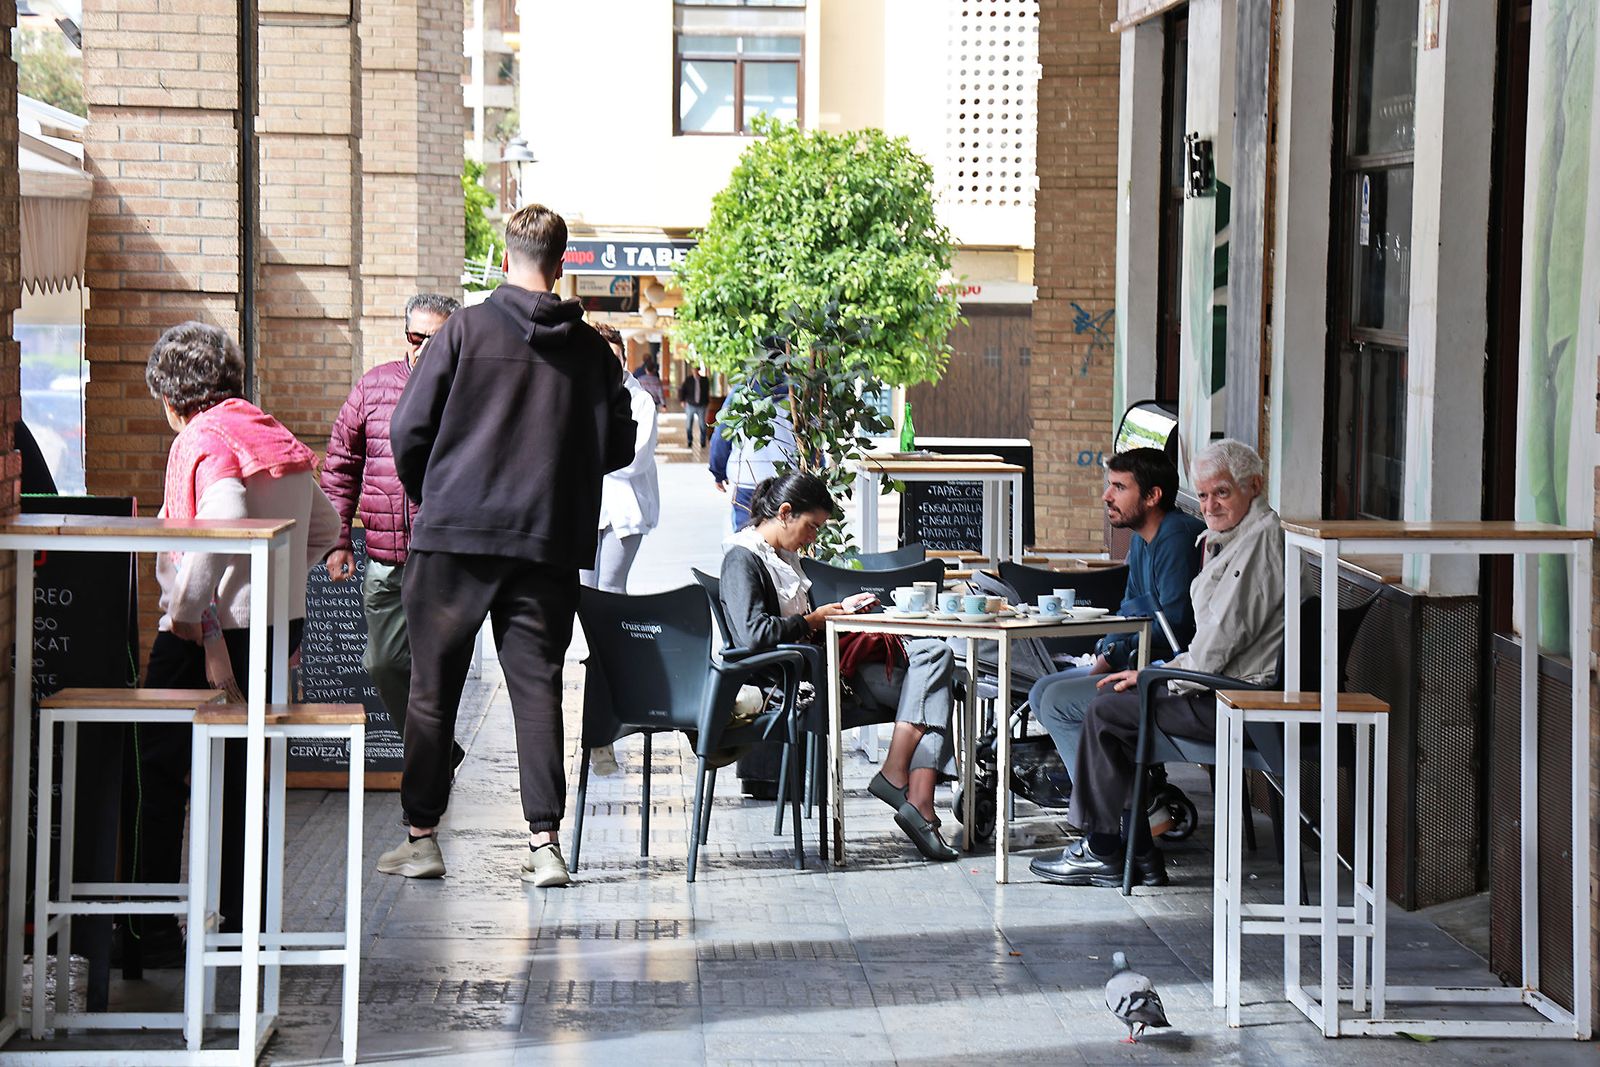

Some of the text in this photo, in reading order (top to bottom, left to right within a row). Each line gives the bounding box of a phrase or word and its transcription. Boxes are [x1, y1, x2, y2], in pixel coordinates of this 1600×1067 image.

[931, 485, 962, 497] TAPAS
[922, 527, 961, 539] PATATAS
[306, 609, 362, 619] HEINEKEN
[307, 620, 333, 631] 1906
[621, 620, 662, 634] Cruzcampo
[307, 632, 333, 643] 1906
[307, 642, 333, 653] 1906
[307, 677, 343, 688] JUDAS
[306, 688, 357, 699] STRAFFE
[290, 745, 343, 757] CERVEZA
